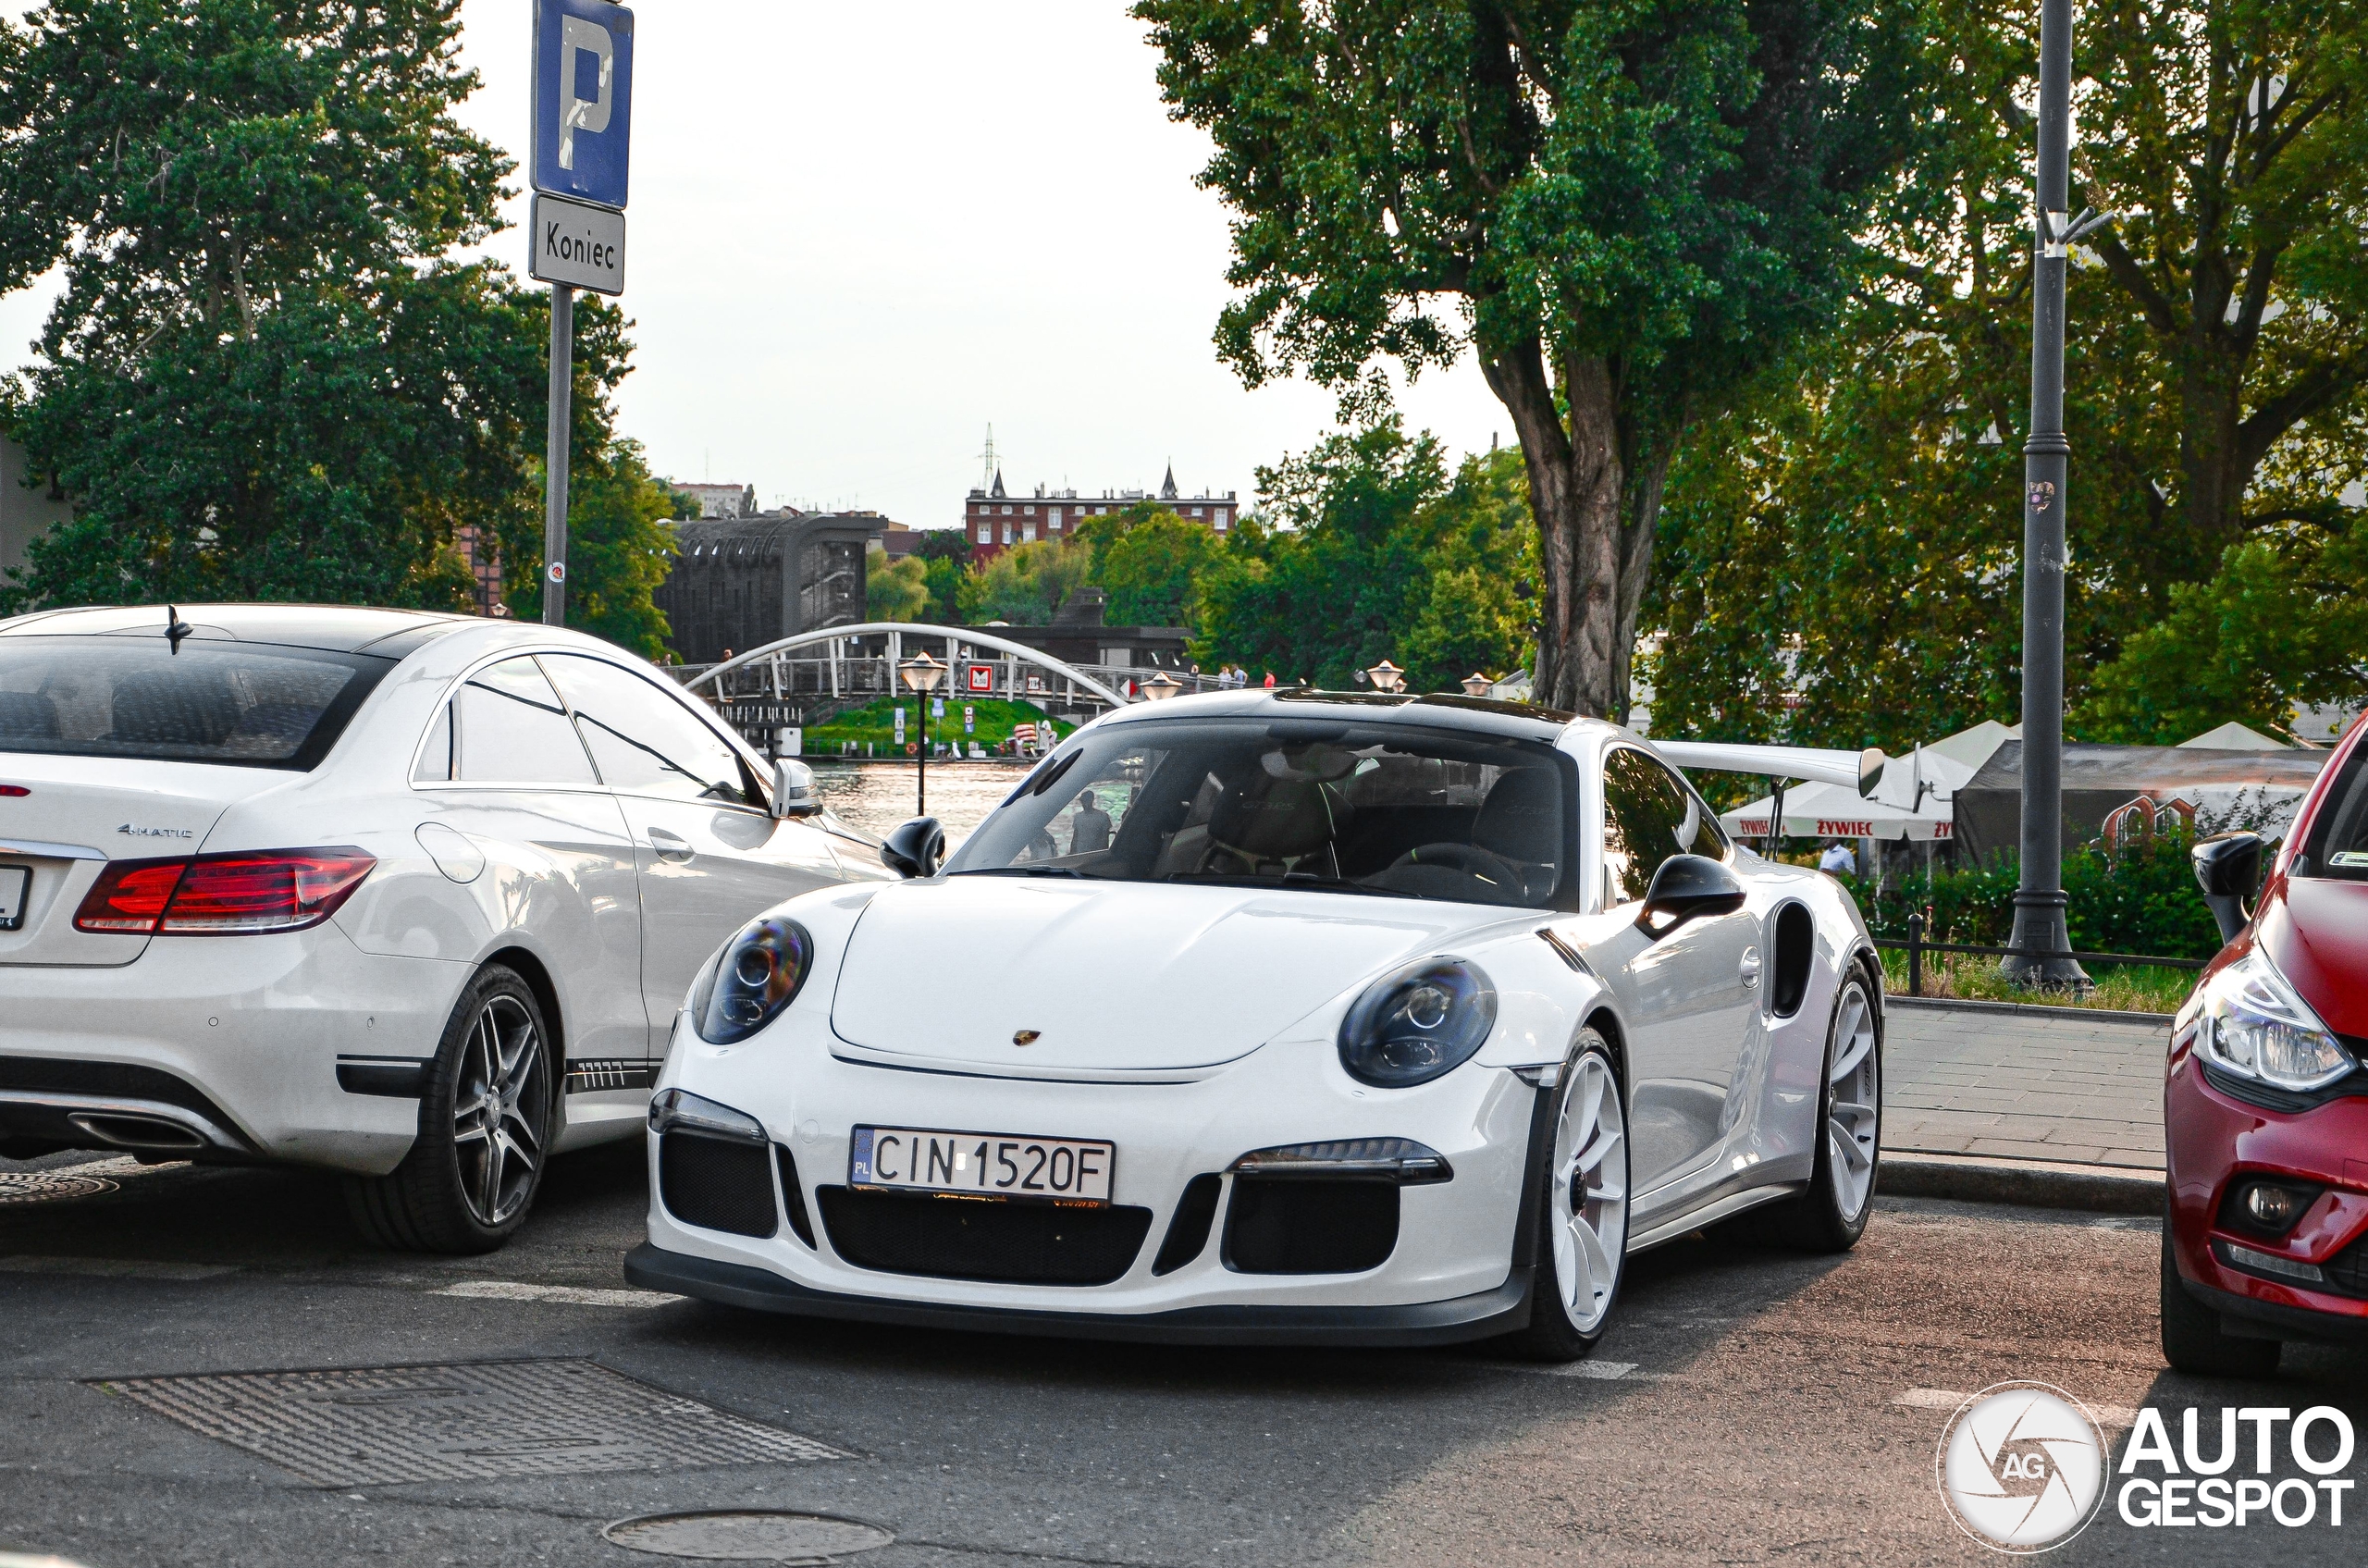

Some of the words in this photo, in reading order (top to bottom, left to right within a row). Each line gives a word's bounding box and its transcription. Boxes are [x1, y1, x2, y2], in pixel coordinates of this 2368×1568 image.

[558, 13, 614, 171] P
[546, 219, 615, 270] Koniec
[117, 823, 193, 838] 4MATIC
[1817, 819, 1873, 836] ŻYWIEC
[855, 1161, 870, 1175] PL
[874, 1135, 955, 1184] CIN
[973, 1141, 1105, 1193] 1520F
